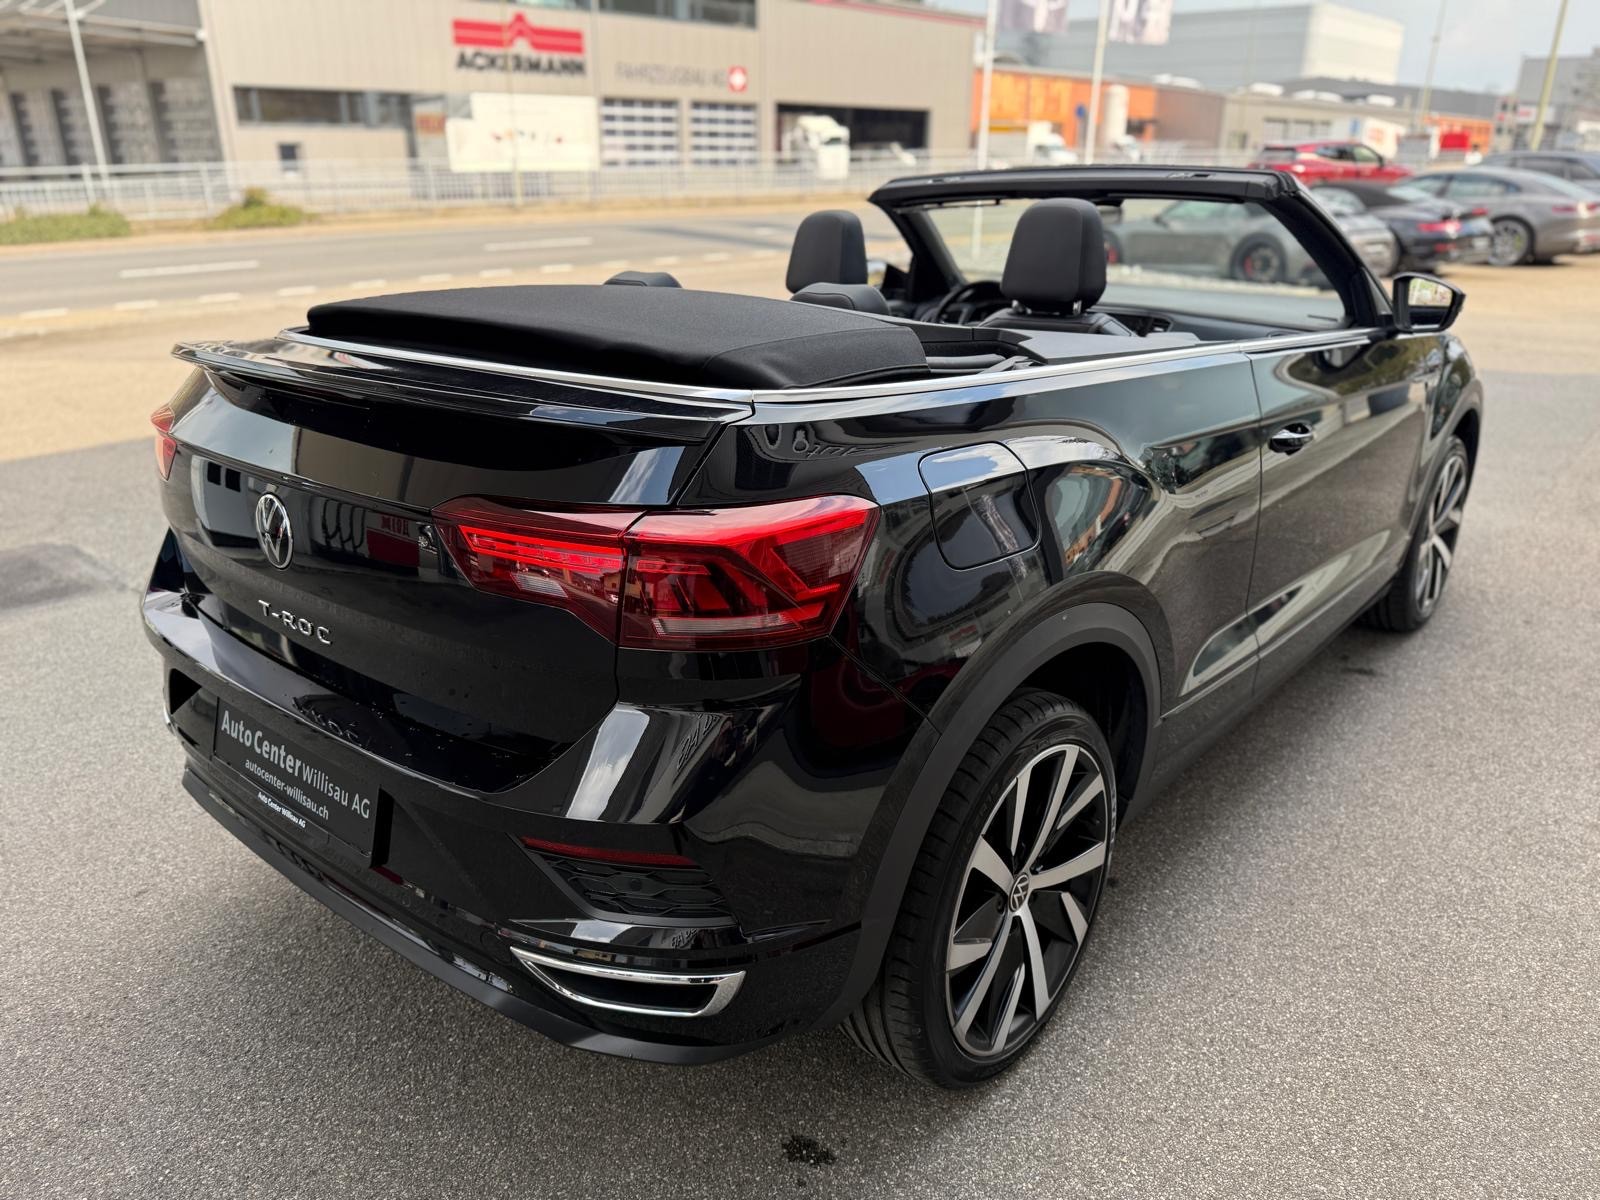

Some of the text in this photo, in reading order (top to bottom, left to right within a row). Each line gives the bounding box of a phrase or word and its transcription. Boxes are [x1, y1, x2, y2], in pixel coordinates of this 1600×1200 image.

[456, 50, 587, 76] ACKERMANN
[258, 599, 332, 645] T-ROC
[221, 710, 370, 819] Auto Center Willisau AG
[244, 758, 329, 820] autocenter-willisau.ch
[257, 791, 307, 829] Auto Center Willisau AG
